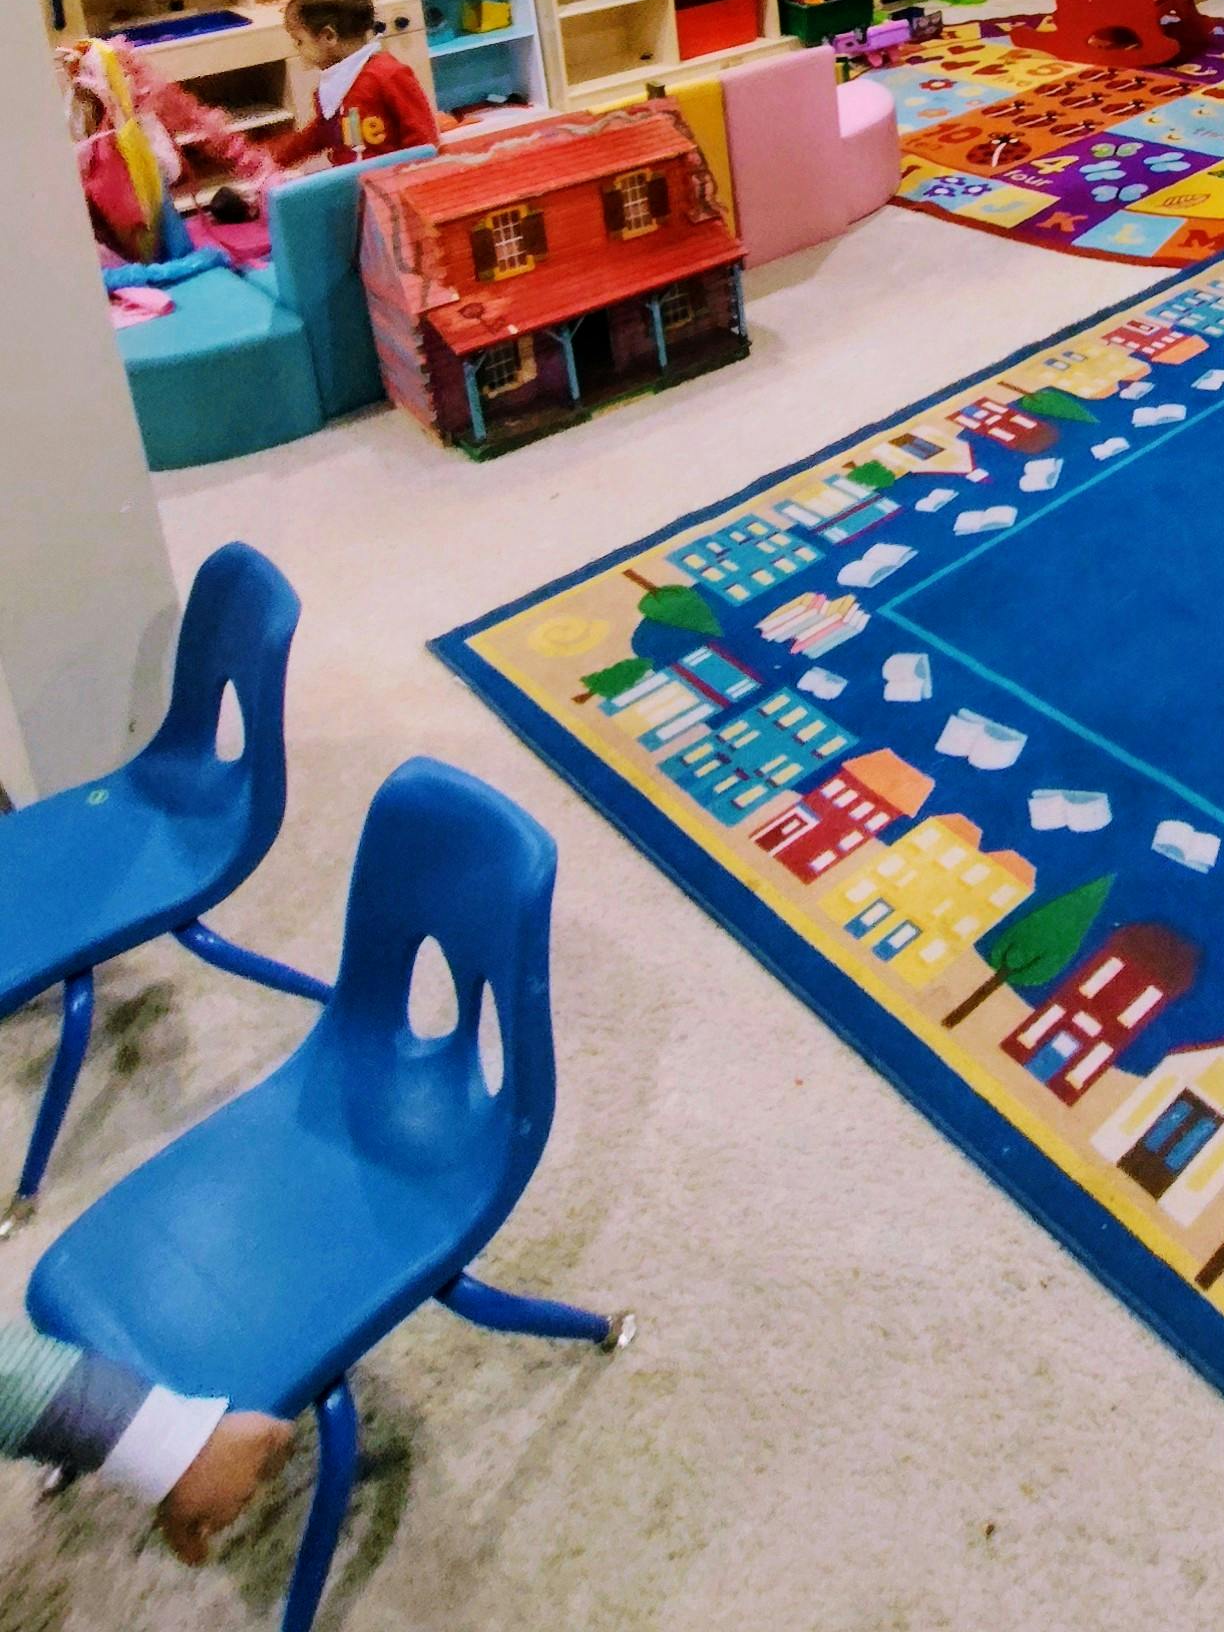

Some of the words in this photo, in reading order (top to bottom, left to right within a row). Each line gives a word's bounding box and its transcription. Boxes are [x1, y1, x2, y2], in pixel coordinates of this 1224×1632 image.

[1030, 155, 1080, 174] 4
[1002, 169, 1054, 187] four
[1035, 211, 1089, 233] K
[1111, 222, 1144, 246] L
